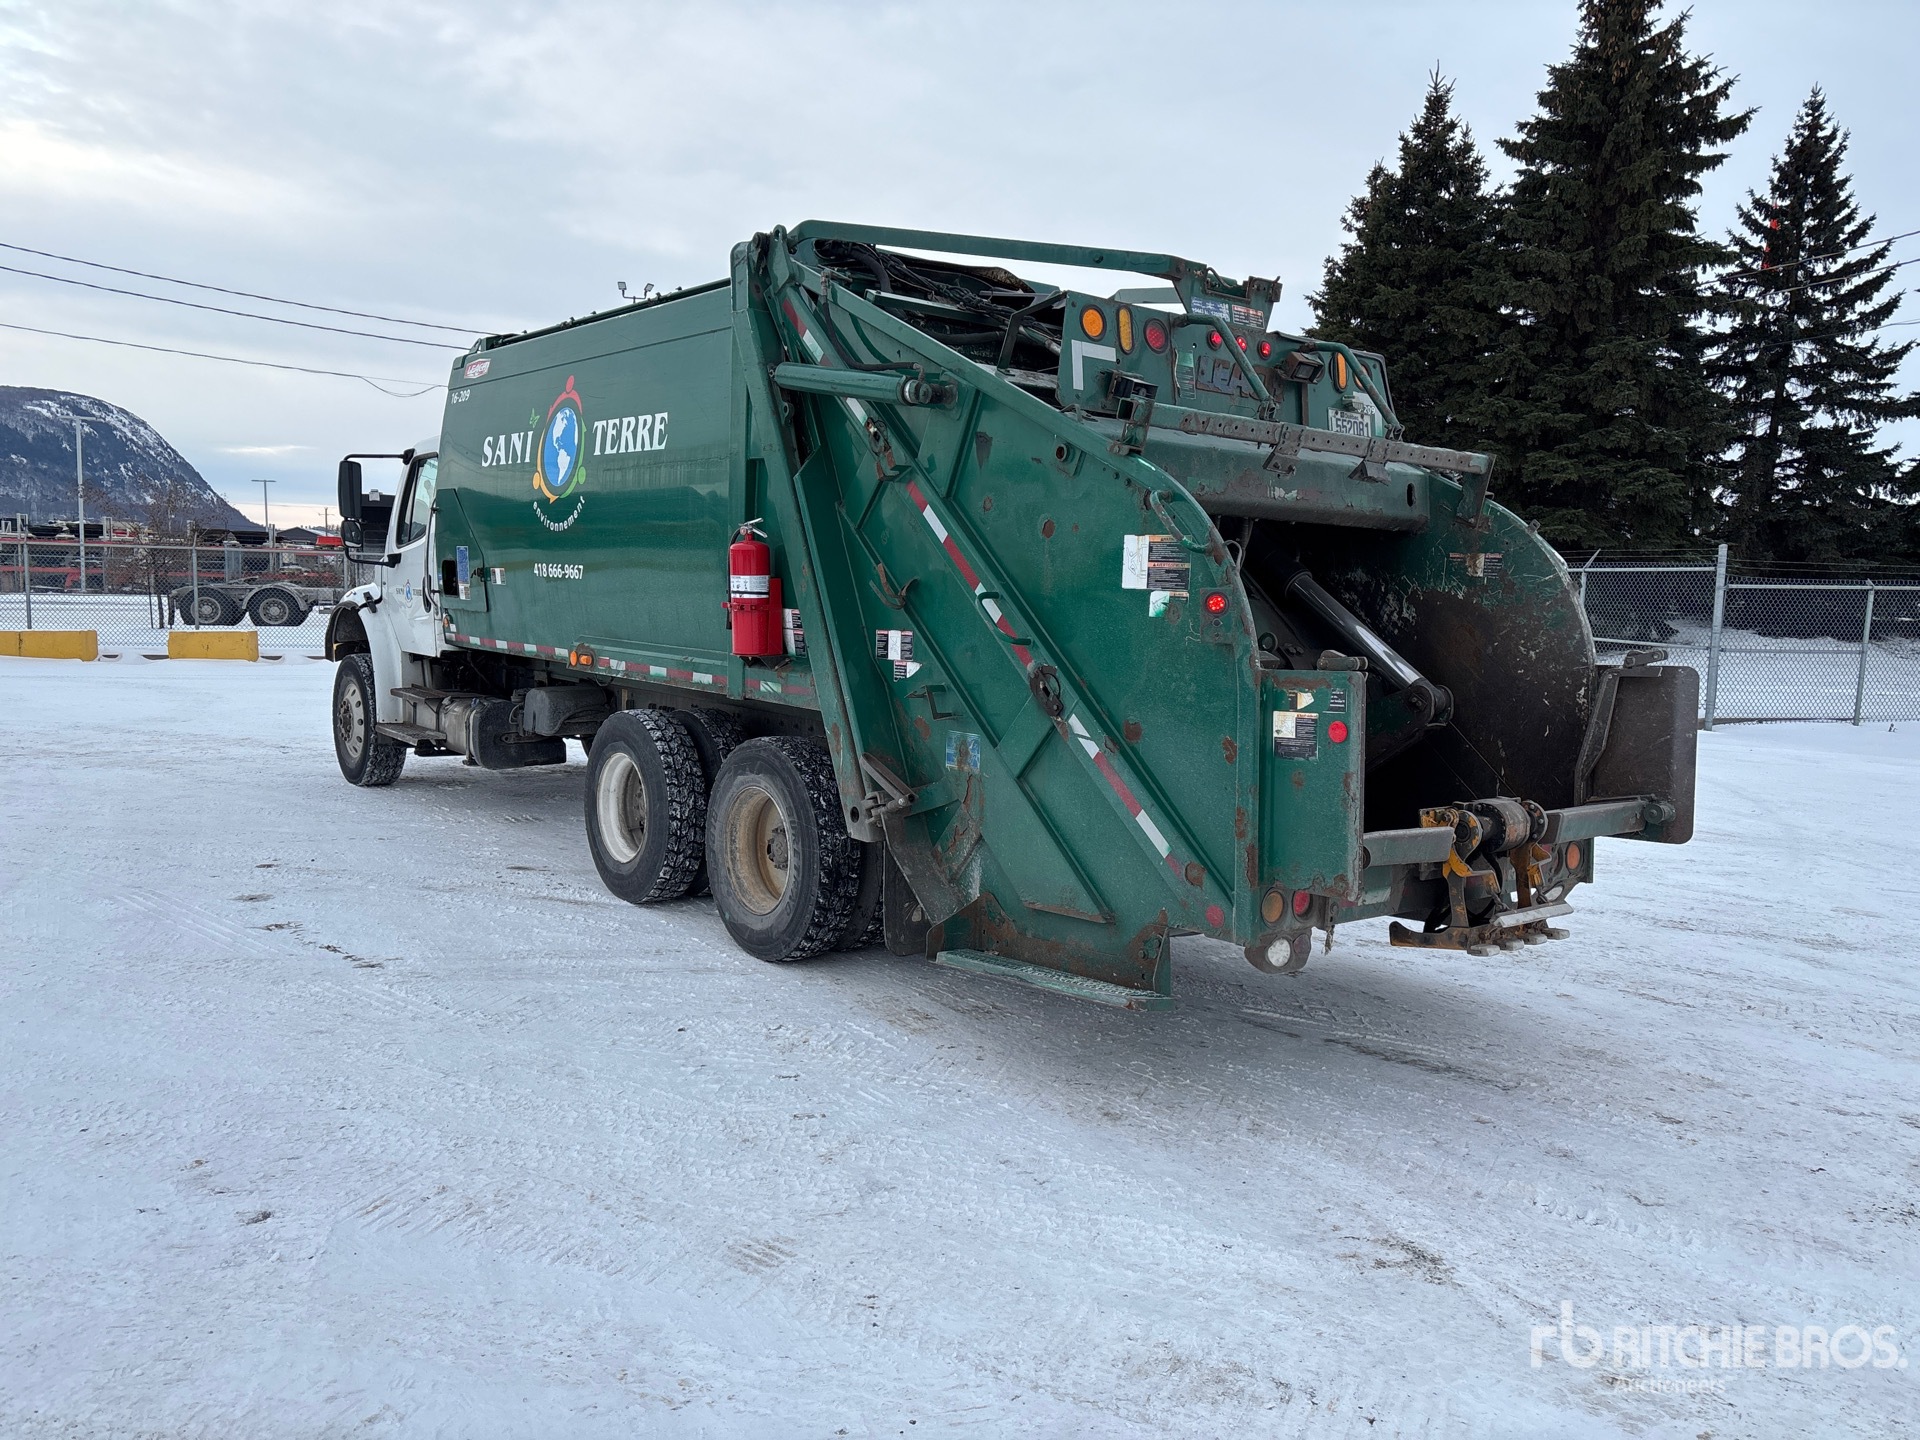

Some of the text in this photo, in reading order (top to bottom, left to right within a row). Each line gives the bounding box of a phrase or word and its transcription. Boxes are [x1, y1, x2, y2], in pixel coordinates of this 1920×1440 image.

[451, 389, 471, 404] 16-209
[481, 412, 669, 467] SANI TERRE
[533, 495, 585, 532] environnement
[533, 563, 584, 580] 418 666-9667
